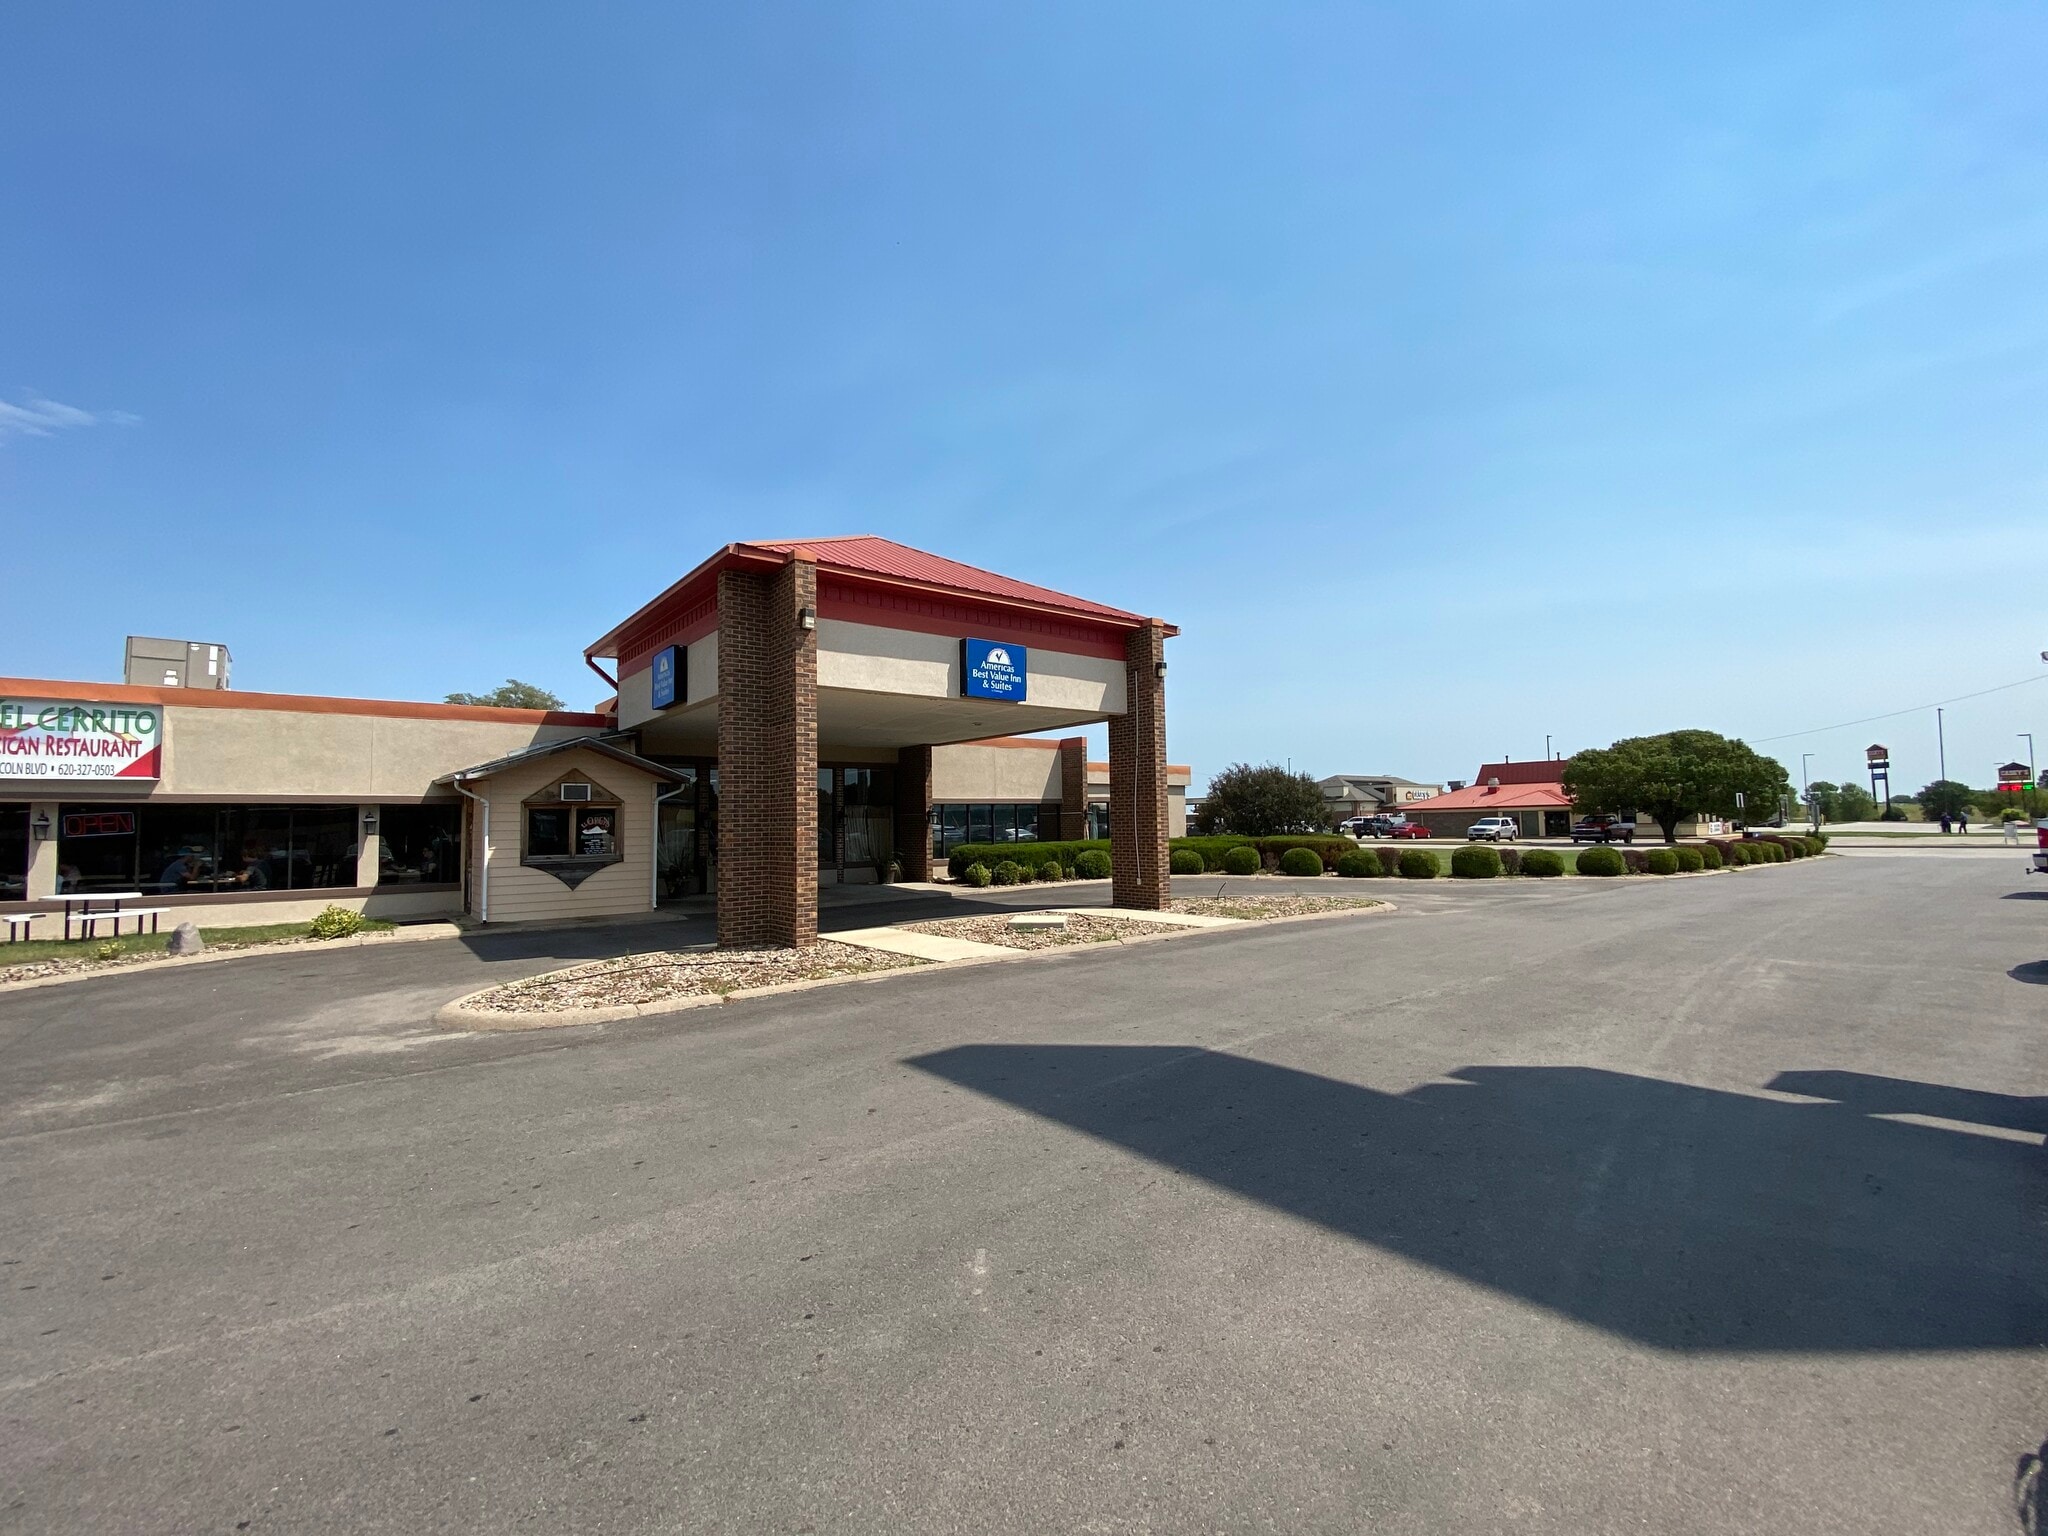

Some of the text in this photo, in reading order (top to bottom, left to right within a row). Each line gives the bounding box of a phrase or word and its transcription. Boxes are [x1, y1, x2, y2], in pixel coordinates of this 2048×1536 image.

[981, 661, 1015, 673] Americas
[972, 669, 1022, 683] Best Value Inn
[982, 679, 1013, 691] & Suites
[1, 705, 157, 735] EL CERRITO
[0, 735, 142, 758] ICAN RESTAURANT
[25, 763, 48, 775] BLVD
[58, 764, 115, 776] 620-327-0503
[66, 814, 133, 836] OPEN
